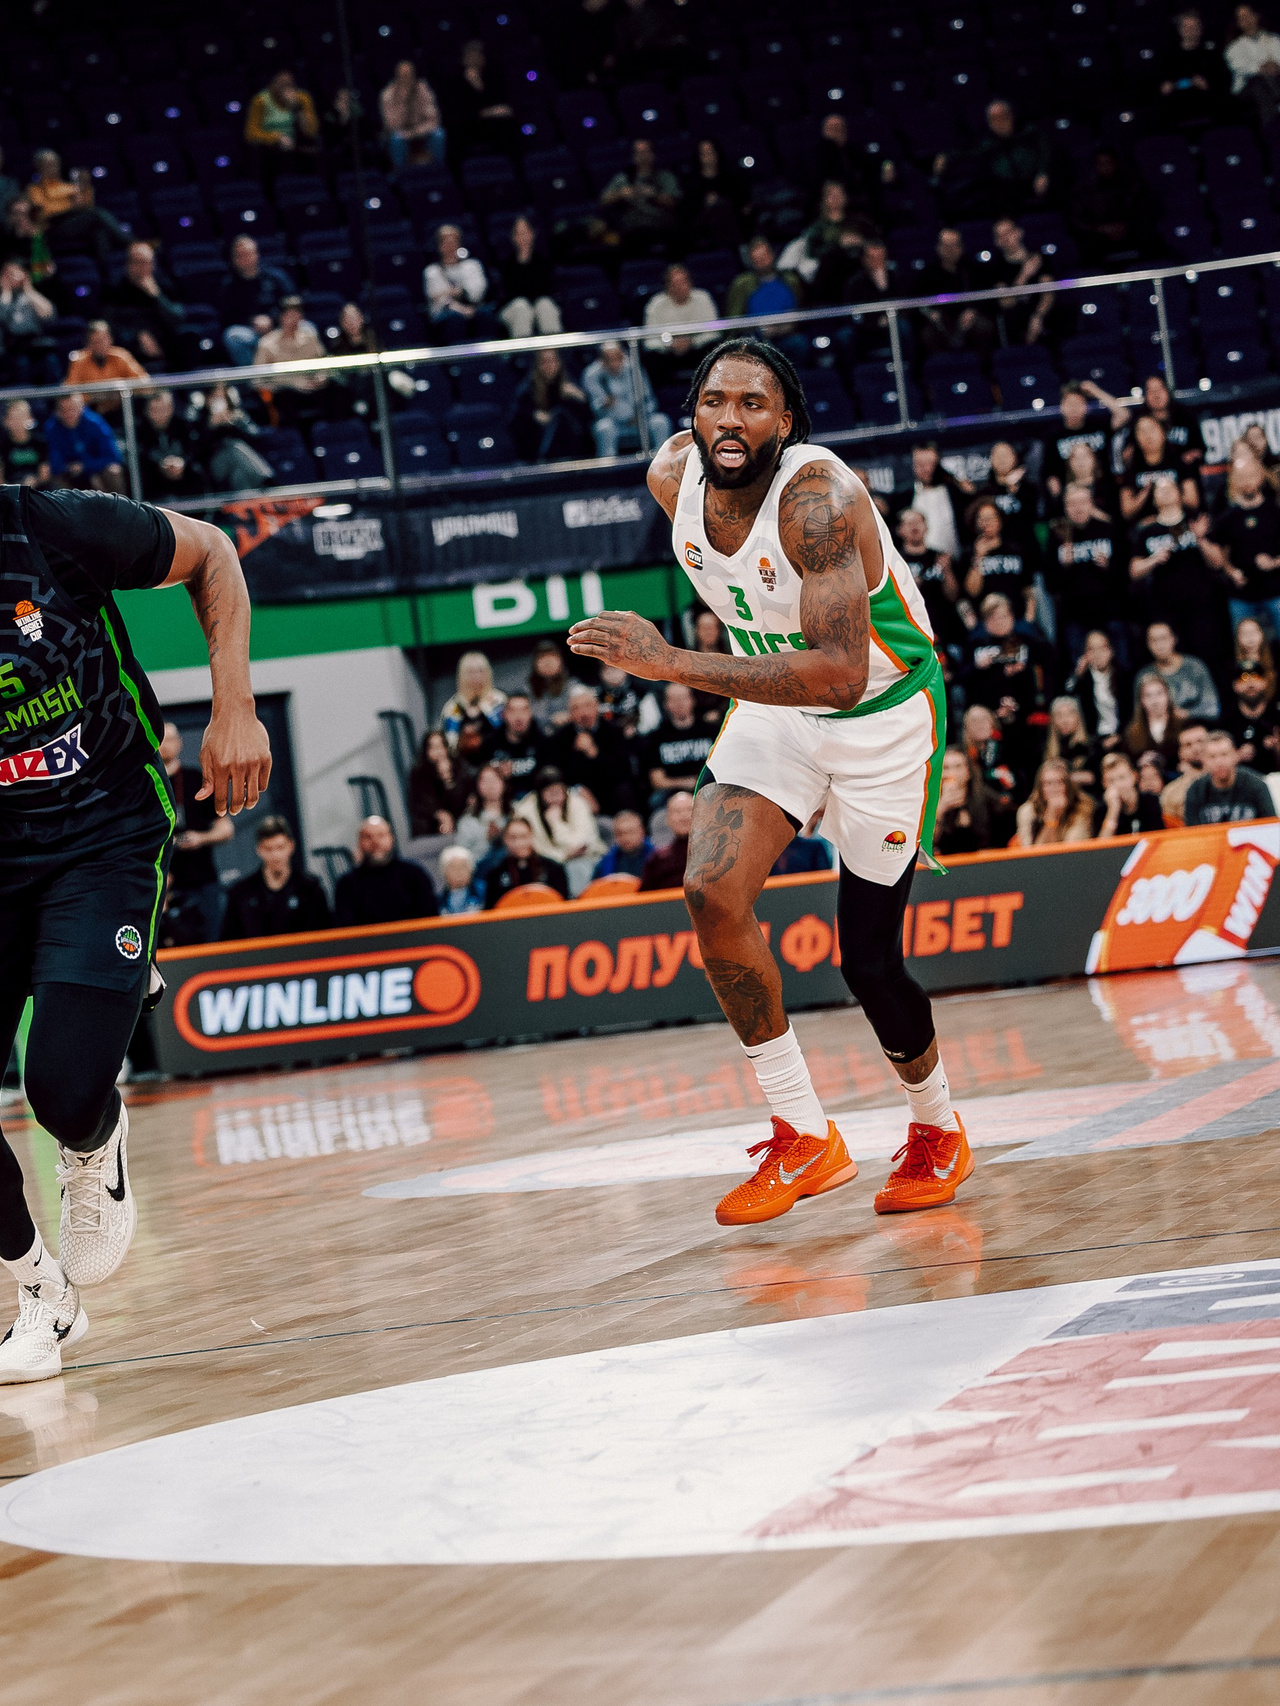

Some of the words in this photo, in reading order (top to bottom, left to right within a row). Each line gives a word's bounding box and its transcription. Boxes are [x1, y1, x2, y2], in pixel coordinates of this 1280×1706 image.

[727, 585, 754, 621] 3
[780, 891, 1024, 973] ФБЕТ
[198, 967, 414, 1035] WINLINE
